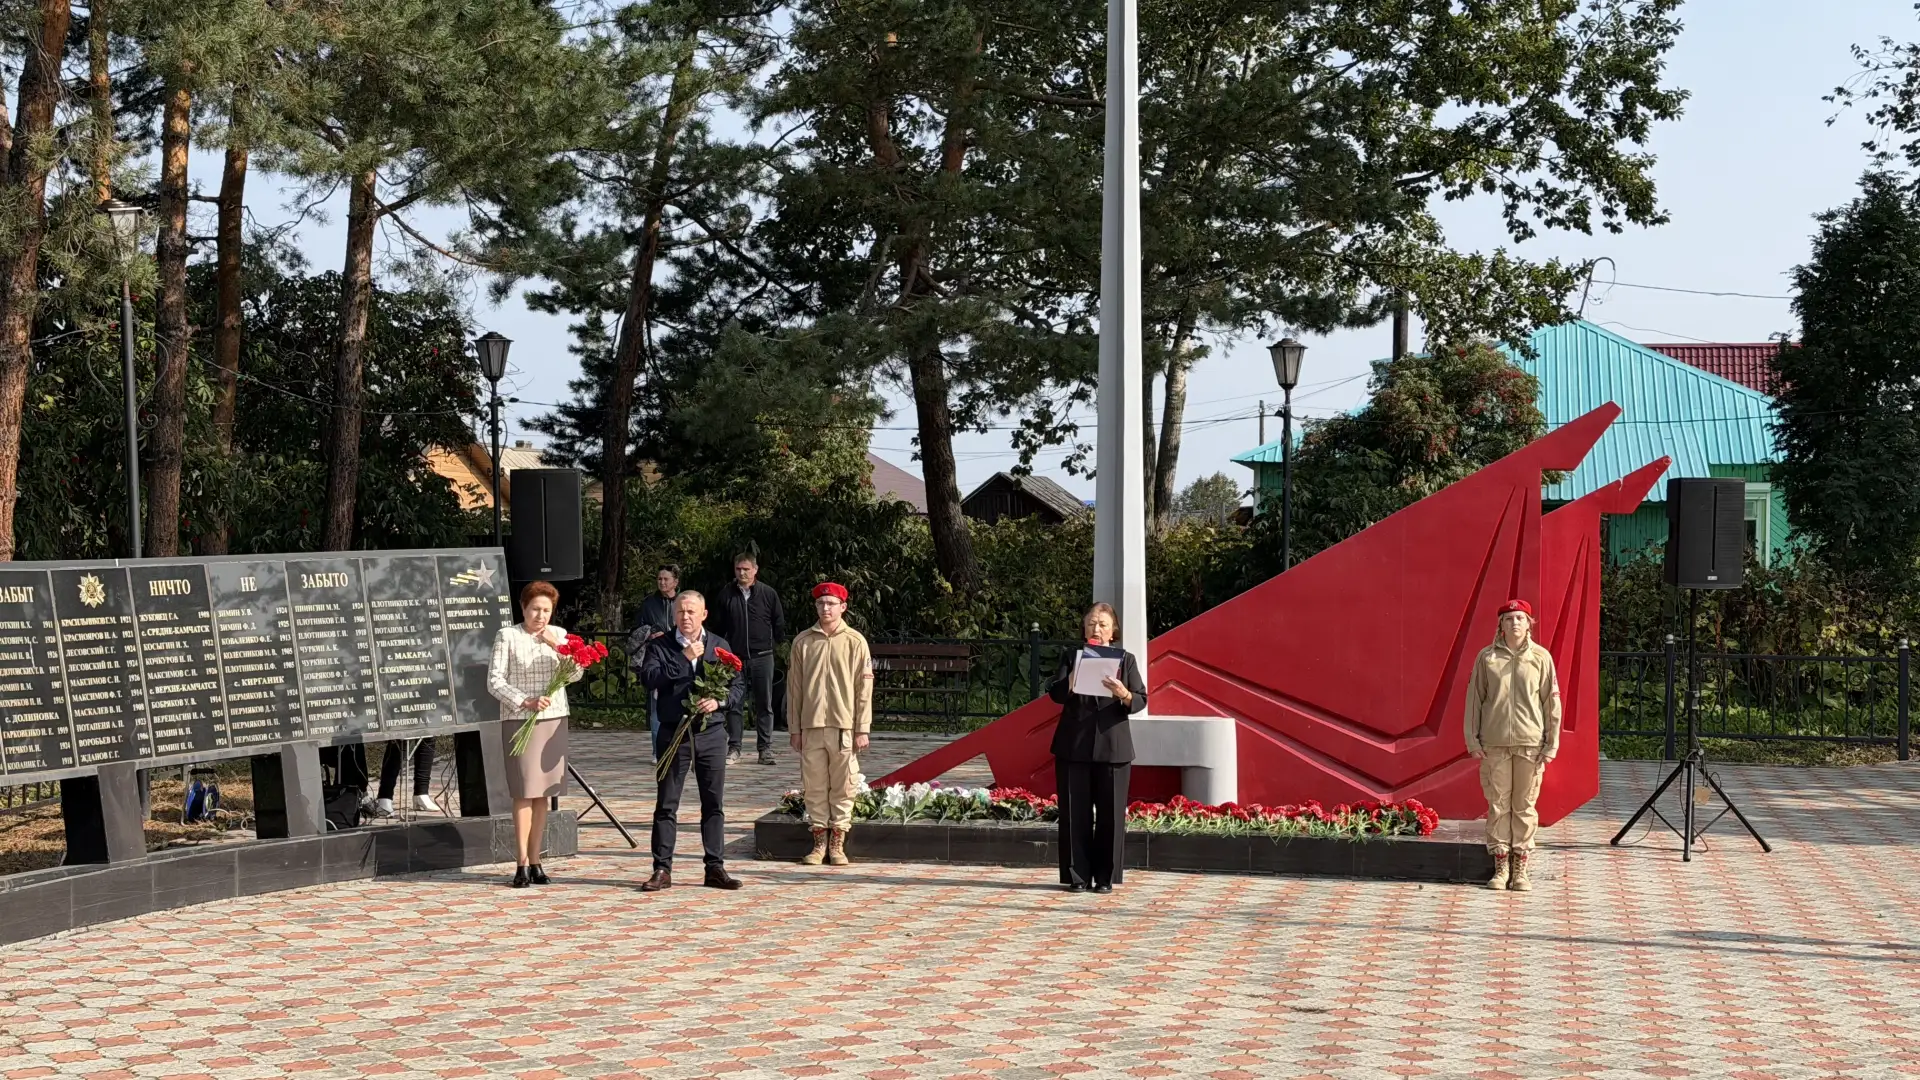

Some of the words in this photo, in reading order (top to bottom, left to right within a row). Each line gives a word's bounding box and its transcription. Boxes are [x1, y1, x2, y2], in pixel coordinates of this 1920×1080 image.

[149, 579, 191, 596] НИЧТО
[240, 576, 257, 592] НЕ
[301, 572, 349, 589] ЗАБЫТО
[371, 599, 408, 609] ПЛОТНИКОВ
[296, 616, 334, 628] ПЛОТНИКОВ
[147, 624, 210, 637] СРЕДНЕ-КАМЧАТСК
[298, 630, 336, 641] ПЛОТНИКОВ
[221, 636, 259, 646] КОВАЛЕНКО
[65, 645, 104, 658] ЛЕСОВСКИЙ
[124, 644, 136, 653] 1924
[223, 649, 264, 660] КОЛЕСНИКОВ
[300, 645, 325, 654] ЧУРКИН
[394, 650, 432, 660] МАКАРКА
[145, 656, 179, 666] КОЧКУРОВ
[302, 658, 327, 668] ЧУРКИН
[67, 661, 106, 673] ЛЕСОВСКИЙ
[225, 663, 263, 674] ПЛОТНИКОВ
[147, 670, 184, 681] МАКСИМОВ
[241, 674, 285, 687] КИРГАНИК
[398, 676, 432, 686] МАШУРА
[70, 676, 107, 688] МАКСИМОВ
[155, 680, 217, 695] ВЕРХНЕ-КАМЧАТСК
[72, 691, 109, 703] МАКСИМОВ
[228, 691, 262, 702] ПЕРМЯКОВ
[151, 699, 184, 710] БОБРЯКОВ
[307, 697, 341, 709] ГРИГОРЬЕВ
[401, 702, 437, 713] ЩАПИНО
[74, 706, 108, 718] МАСКАЛЕВ
[230, 705, 264, 716] ПЕРМЯКОВ
[11, 711, 60, 724] ДОЛИНОВКА
[153, 712, 191, 724] ВЕРЕЩАГИН
[309, 711, 342, 722] ПЕРМЯКОВ
[232, 719, 266, 730] ПЕРМЯКОВ
[79, 736, 111, 748] ВОРОБЬЕВ
[234, 733, 267, 744] ПЕРМЯКОВ
[80, 751, 108, 763] ЖДАНОВ
